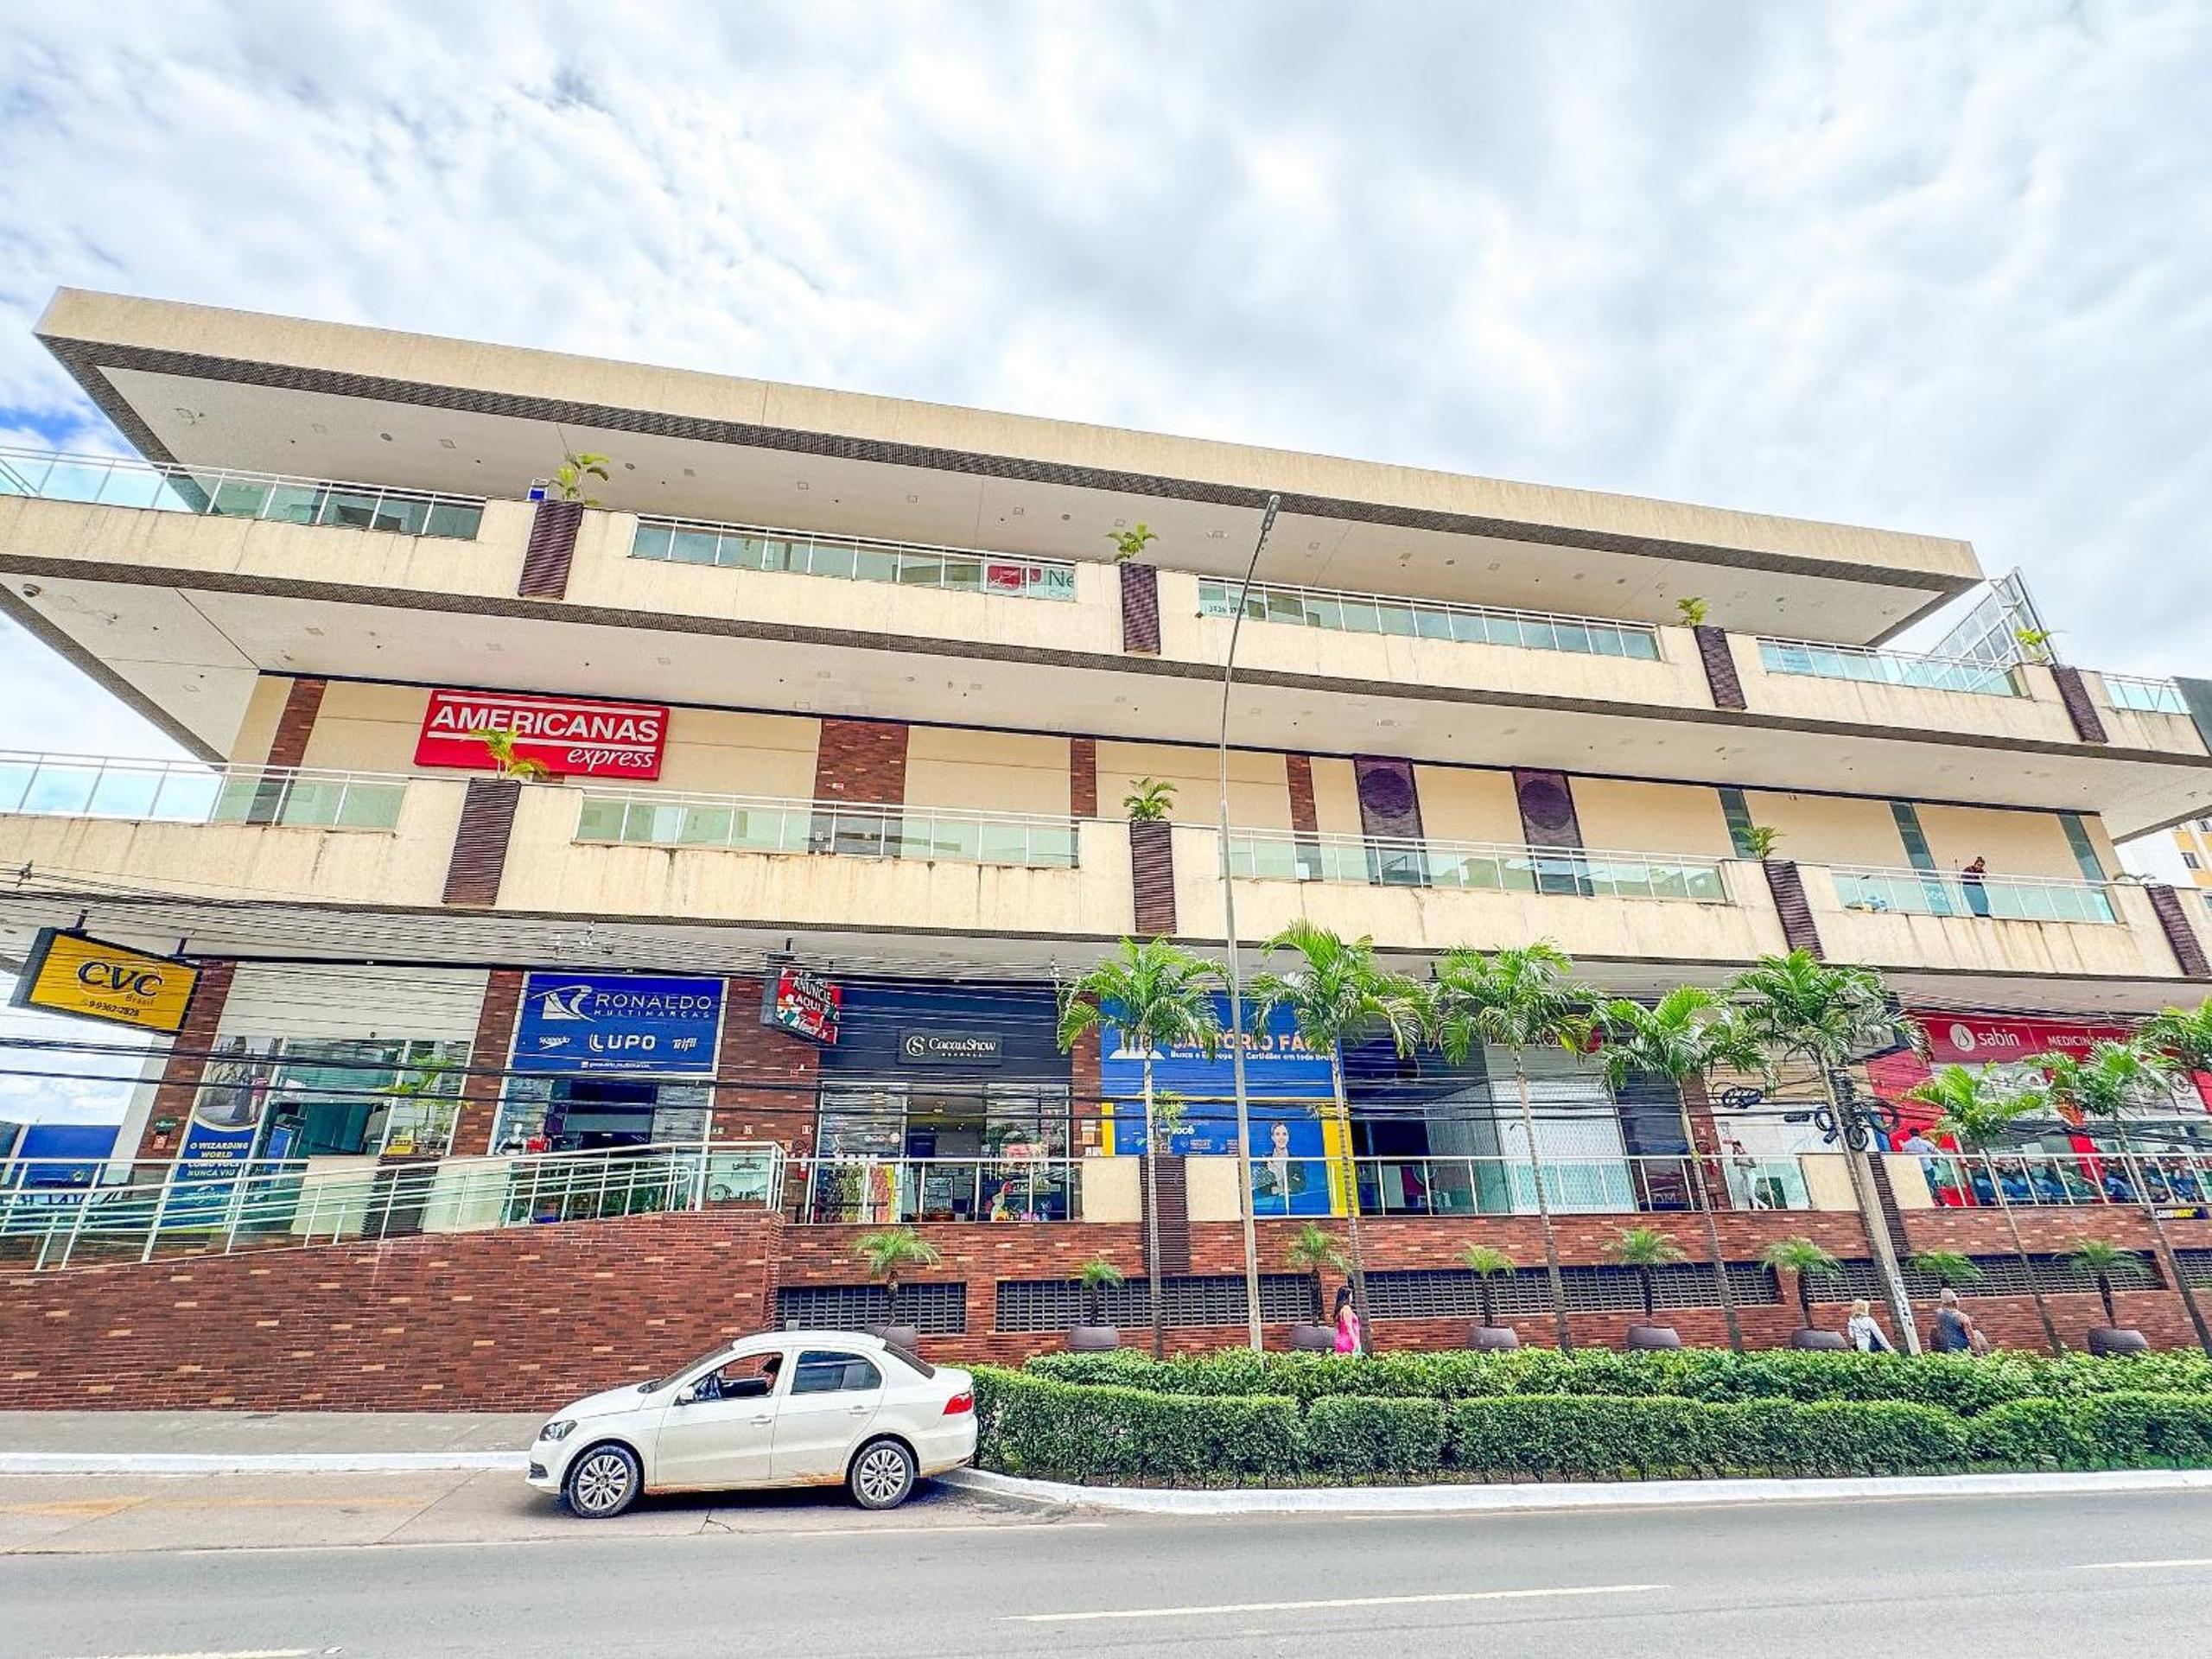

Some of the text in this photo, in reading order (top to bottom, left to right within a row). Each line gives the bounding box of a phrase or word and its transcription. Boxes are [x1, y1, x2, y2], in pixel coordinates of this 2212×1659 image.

[432, 704, 659, 742] AMERICANAS
[567, 747, 655, 772] express
[78, 961, 163, 996] CVC
[125, 995, 154, 1006] Brasil
[595, 993, 712, 1009] RONALDO
[796, 994, 821, 1012] AQUI
[594, 1009, 709, 1018] MULTIMARCAS
[589, 1033, 655, 1052] LUPO
[1173, 1028, 1274, 1051] ATÓRIO
[1977, 1027, 2021, 1046] sabin
